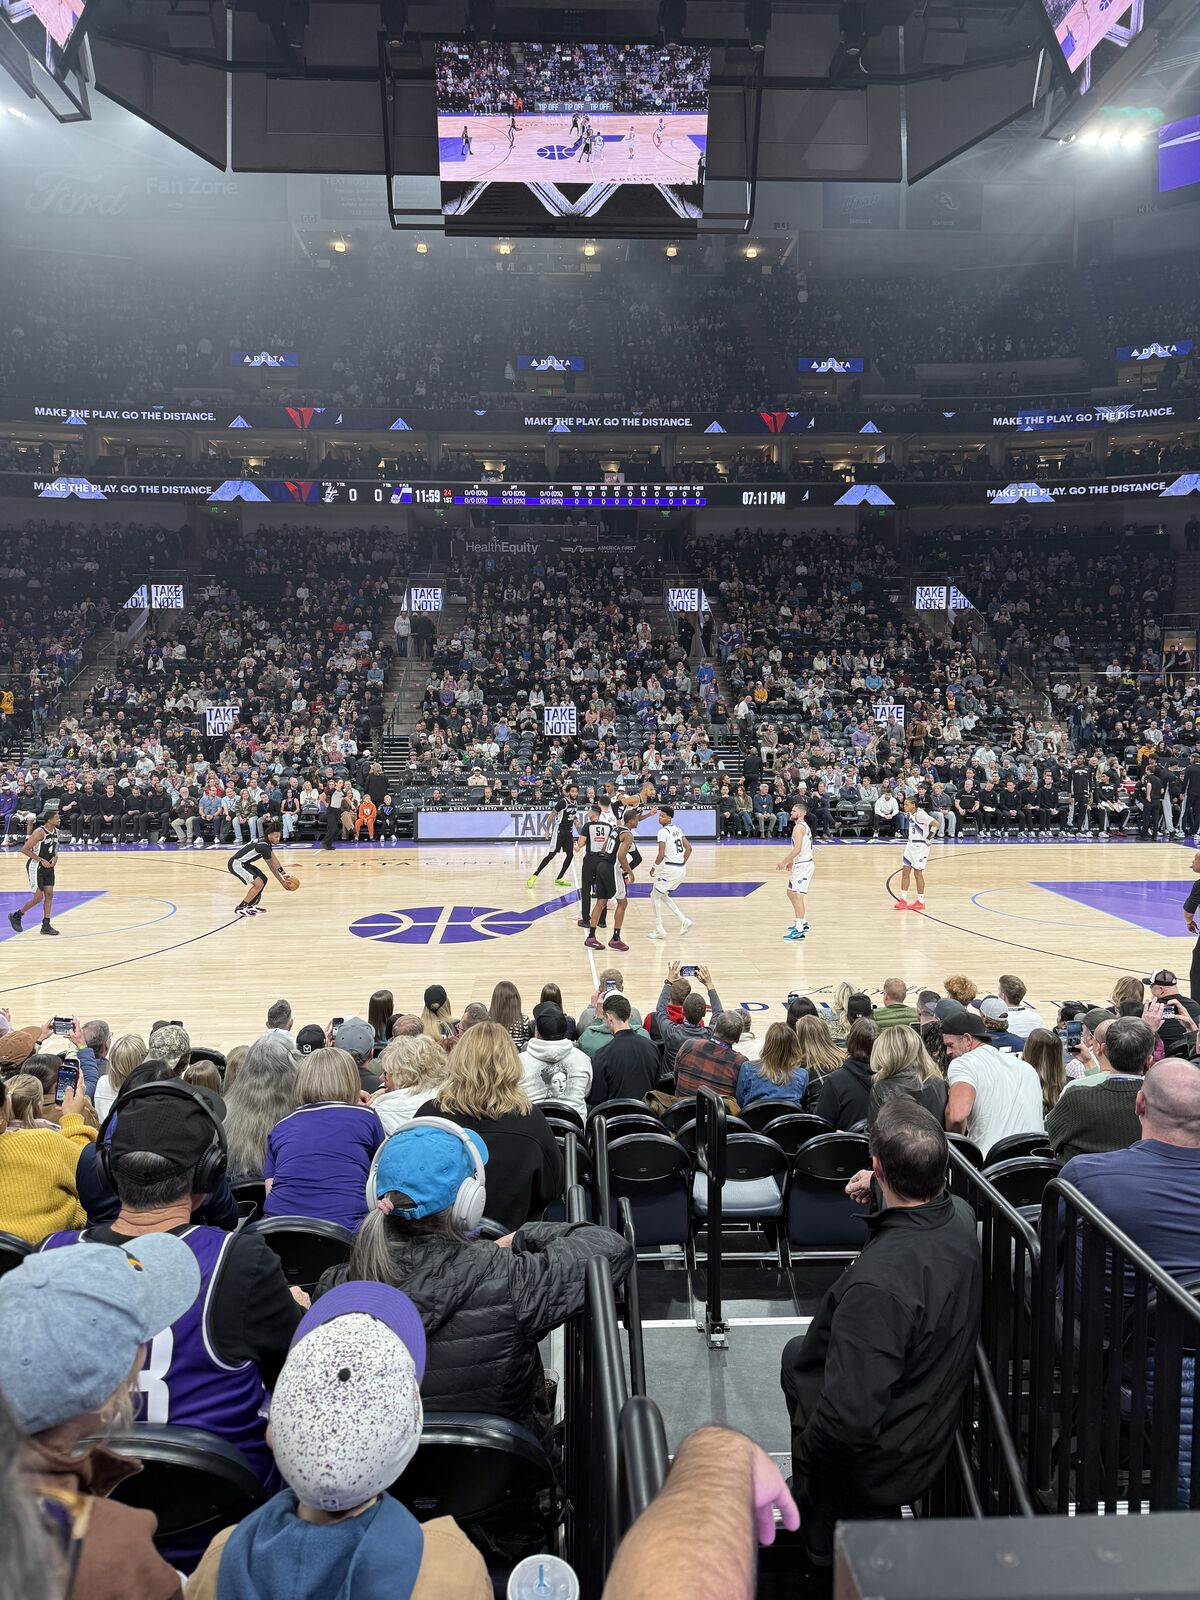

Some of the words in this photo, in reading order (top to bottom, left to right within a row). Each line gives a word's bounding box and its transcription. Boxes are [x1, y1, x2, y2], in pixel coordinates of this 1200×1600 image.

[146, 176, 182, 194] Fan
[189, 177, 238, 195] Zone
[25, 171, 128, 216] Ford
[1142, 345, 1177, 355] DELTA
[34, 407, 67, 416] MAKE
[69, 410, 90, 418] THE
[92, 410, 120, 419] PLAY.
[122, 411, 139, 420] GO
[141, 412, 161, 420] THE
[163, 412, 216, 421] DISTANCE.
[993, 417, 1022, 426] MAKE
[1025, 416, 1044, 425] THE
[1046, 414, 1073, 423] PLAY.
[1076, 414, 1093, 422] GO
[1095, 412, 1115, 421] THE
[1118, 407, 1175, 420] DISTANCE.
[555, 418, 574, 426] THE
[576, 418, 601, 426] PLAY.
[604, 418, 619, 426] GO
[621, 418, 640, 426] THE
[642, 418, 692, 426] DISTANCE.
[34, 482, 66, 492] MAKE
[68, 483, 88, 492] THE
[91, 484, 118, 493] PLAY.
[121, 484, 137, 493] GO
[140, 485, 159, 494] THE
[162, 485, 215, 494] DISTANCE.
[349, 488, 357, 501] 0
[987, 489, 1015, 497] MAKE
[1018, 488, 1037, 497] THE
[1040, 487, 1066, 496] PLAY.
[1069, 486, 1086, 495] GO
[1088, 485, 1108, 494] THE
[1111, 482, 1168, 493] DISTANCE.
[374, 489, 382, 502] 0
[415, 490, 440, 503] 11:59
[742, 491, 767, 505] 07:11
[770, 491, 786, 505] PM
[466, 541, 538, 555] HealthEquity
[154, 585, 180, 596] TAKE
[414, 589, 439, 599] TAKE
[671, 589, 696, 600] TAKE
[919, 587, 944, 598] TAKE
[414, 600, 440, 611] NOTE
[671, 600, 696, 611] NOTE
[207, 708, 238, 721] TAKE
[545, 708, 575, 721] TAKE
[874, 706, 903, 719] TAKE
[546, 722, 575, 735] NOTE
[511, 813, 552, 836] TAK
[596, 827, 605, 836] 54
[48, 845, 53, 853] 4
[674, 839, 683, 853] 19
